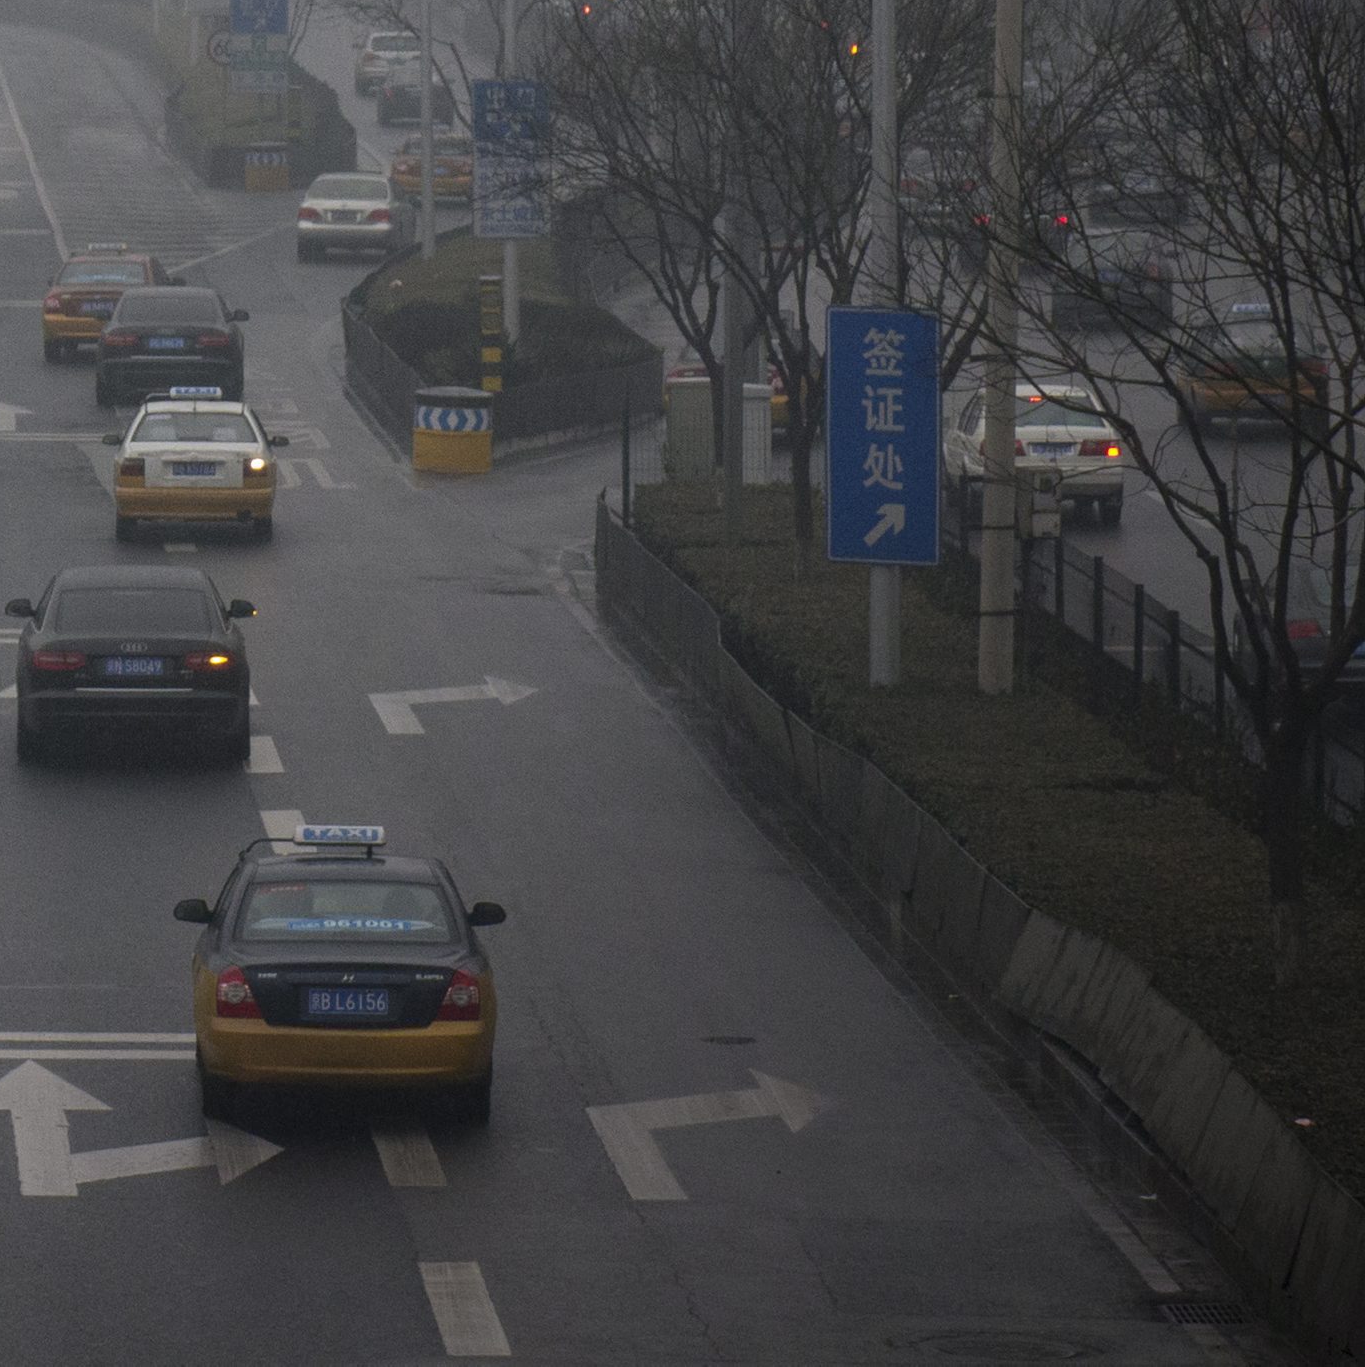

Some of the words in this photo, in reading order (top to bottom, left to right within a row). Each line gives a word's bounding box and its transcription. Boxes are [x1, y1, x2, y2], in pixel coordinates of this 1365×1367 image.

[863, 328, 906, 491] 签证处
[308, 827, 375, 839] TAXI
[324, 919, 407, 931] 961001
